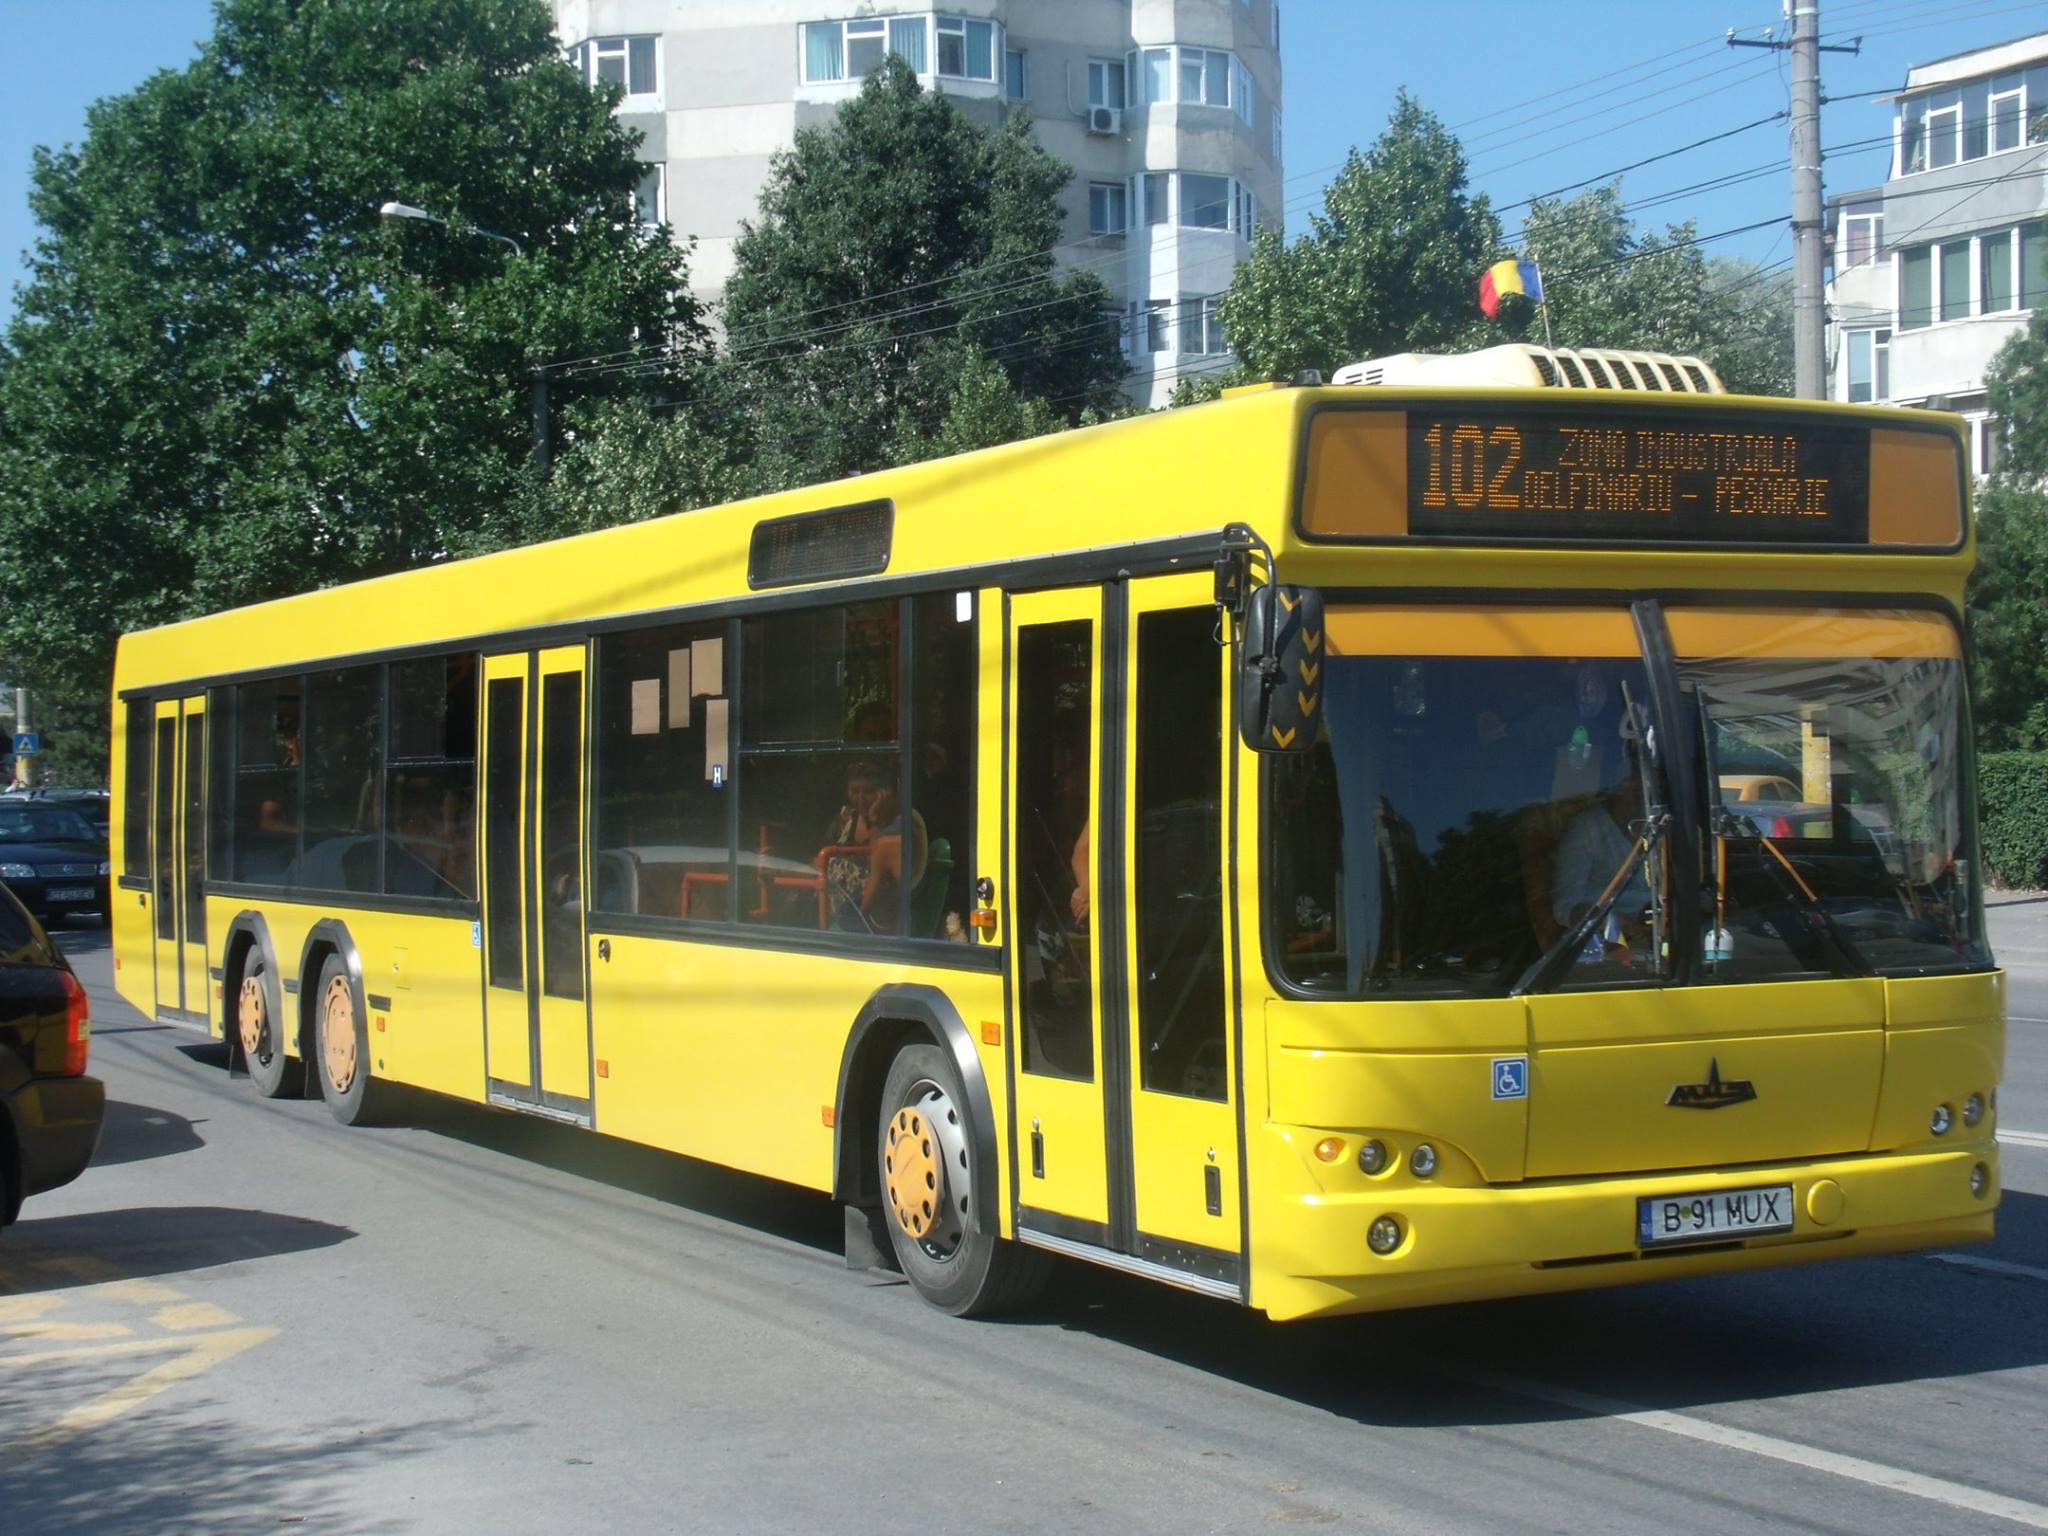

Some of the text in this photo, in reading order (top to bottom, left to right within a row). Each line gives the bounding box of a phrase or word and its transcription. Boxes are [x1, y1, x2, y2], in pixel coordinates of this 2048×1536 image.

[1424, 424, 1520, 508] 102
[1559, 428, 1796, 473] ZONA INDUSTRIALA
[1524, 471, 1672, 511] DELFINARIU
[1715, 476, 1828, 515] PESCARIE
[1664, 1193, 1780, 1231] B 91 MUX
